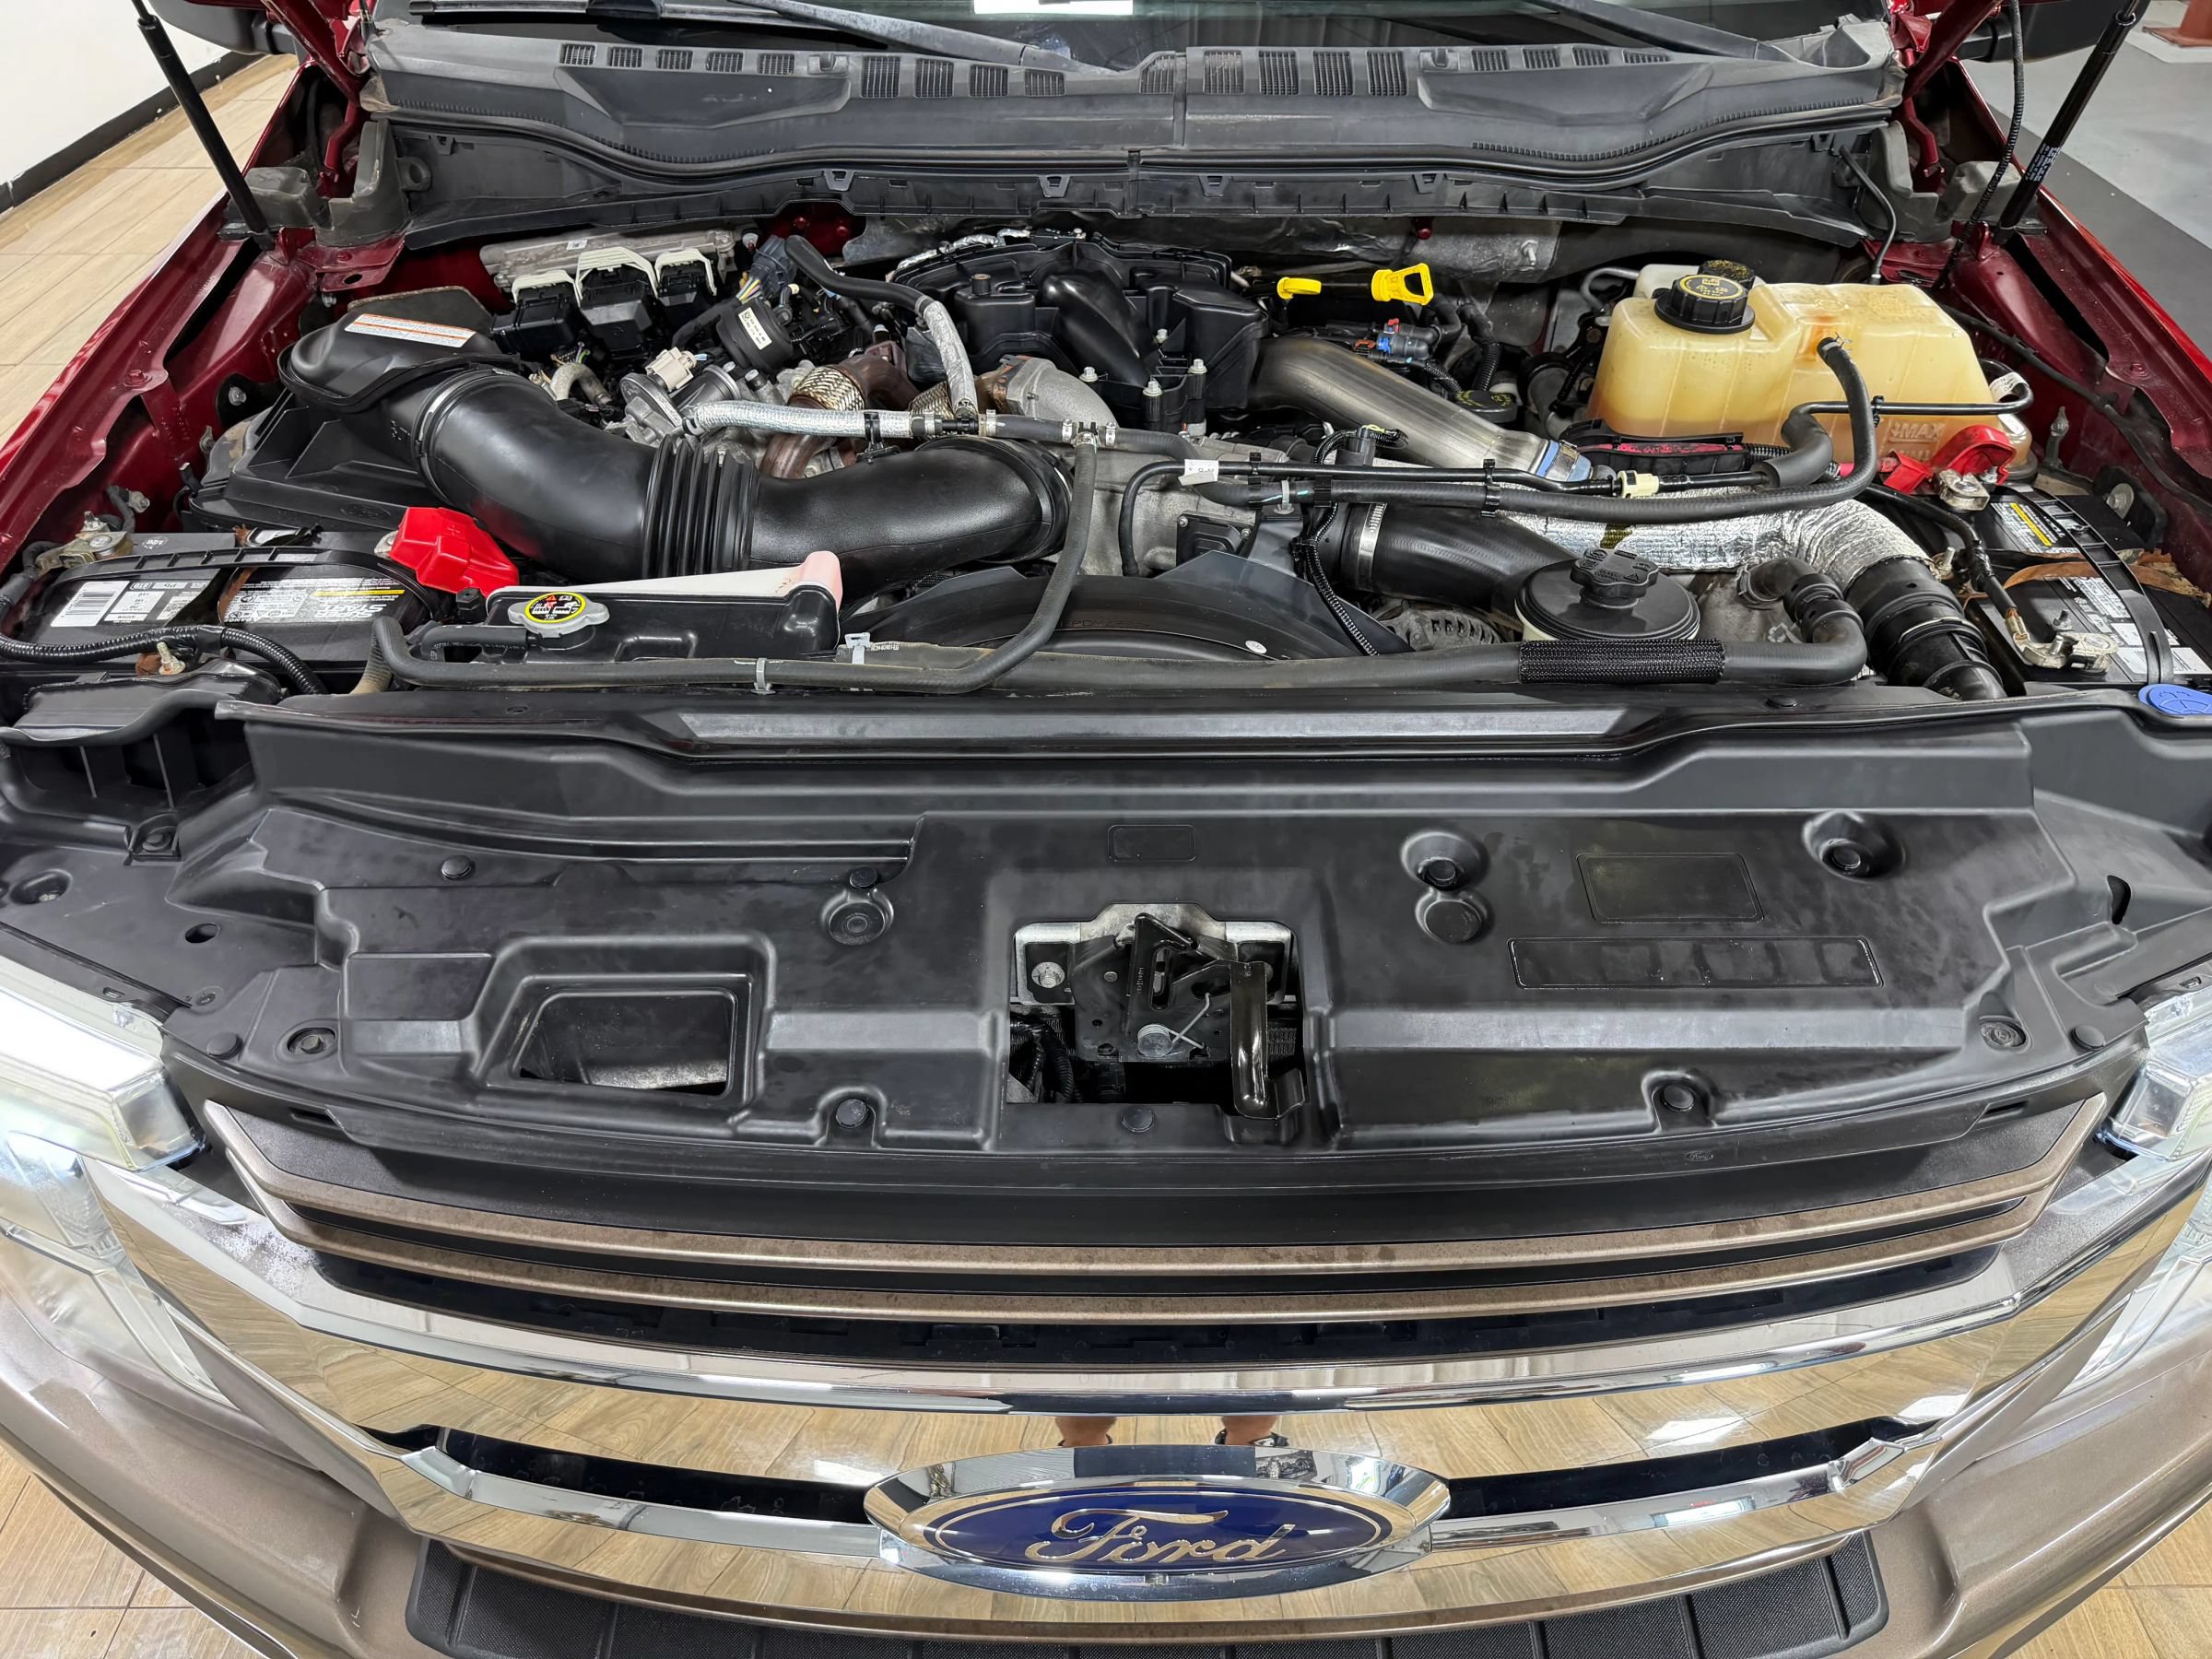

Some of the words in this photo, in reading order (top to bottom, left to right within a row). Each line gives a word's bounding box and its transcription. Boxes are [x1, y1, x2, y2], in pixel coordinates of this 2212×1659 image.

[321, 604, 387, 613] START
[313, 610, 374, 618] SUPER
[1024, 1508, 1297, 1564] Ford
